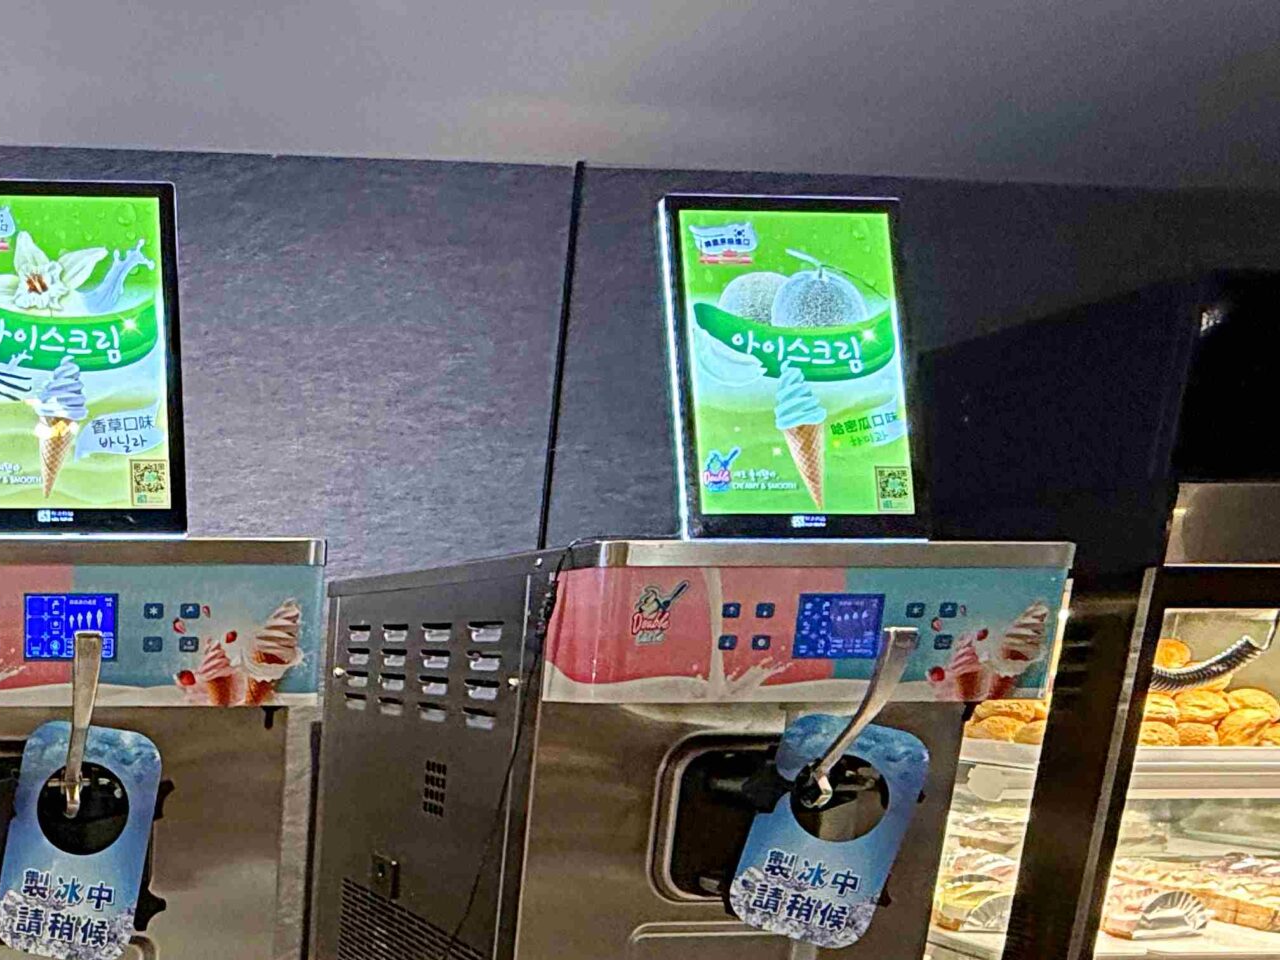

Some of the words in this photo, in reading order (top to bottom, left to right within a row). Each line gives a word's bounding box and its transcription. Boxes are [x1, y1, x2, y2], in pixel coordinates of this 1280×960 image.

[731, 330, 864, 374] 아이스크림
[92, 415, 155, 434] 香草口味
[99, 433, 148, 453] 바닐라
[830, 412, 898, 435] 哈密瓜口味
[631, 610, 671, 635] Double
[23, 869, 114, 910] 製冰中
[764, 849, 860, 895] 製冰中
[16, 906, 109, 947] 請稍候
[751, 884, 848, 932] 請稍候
